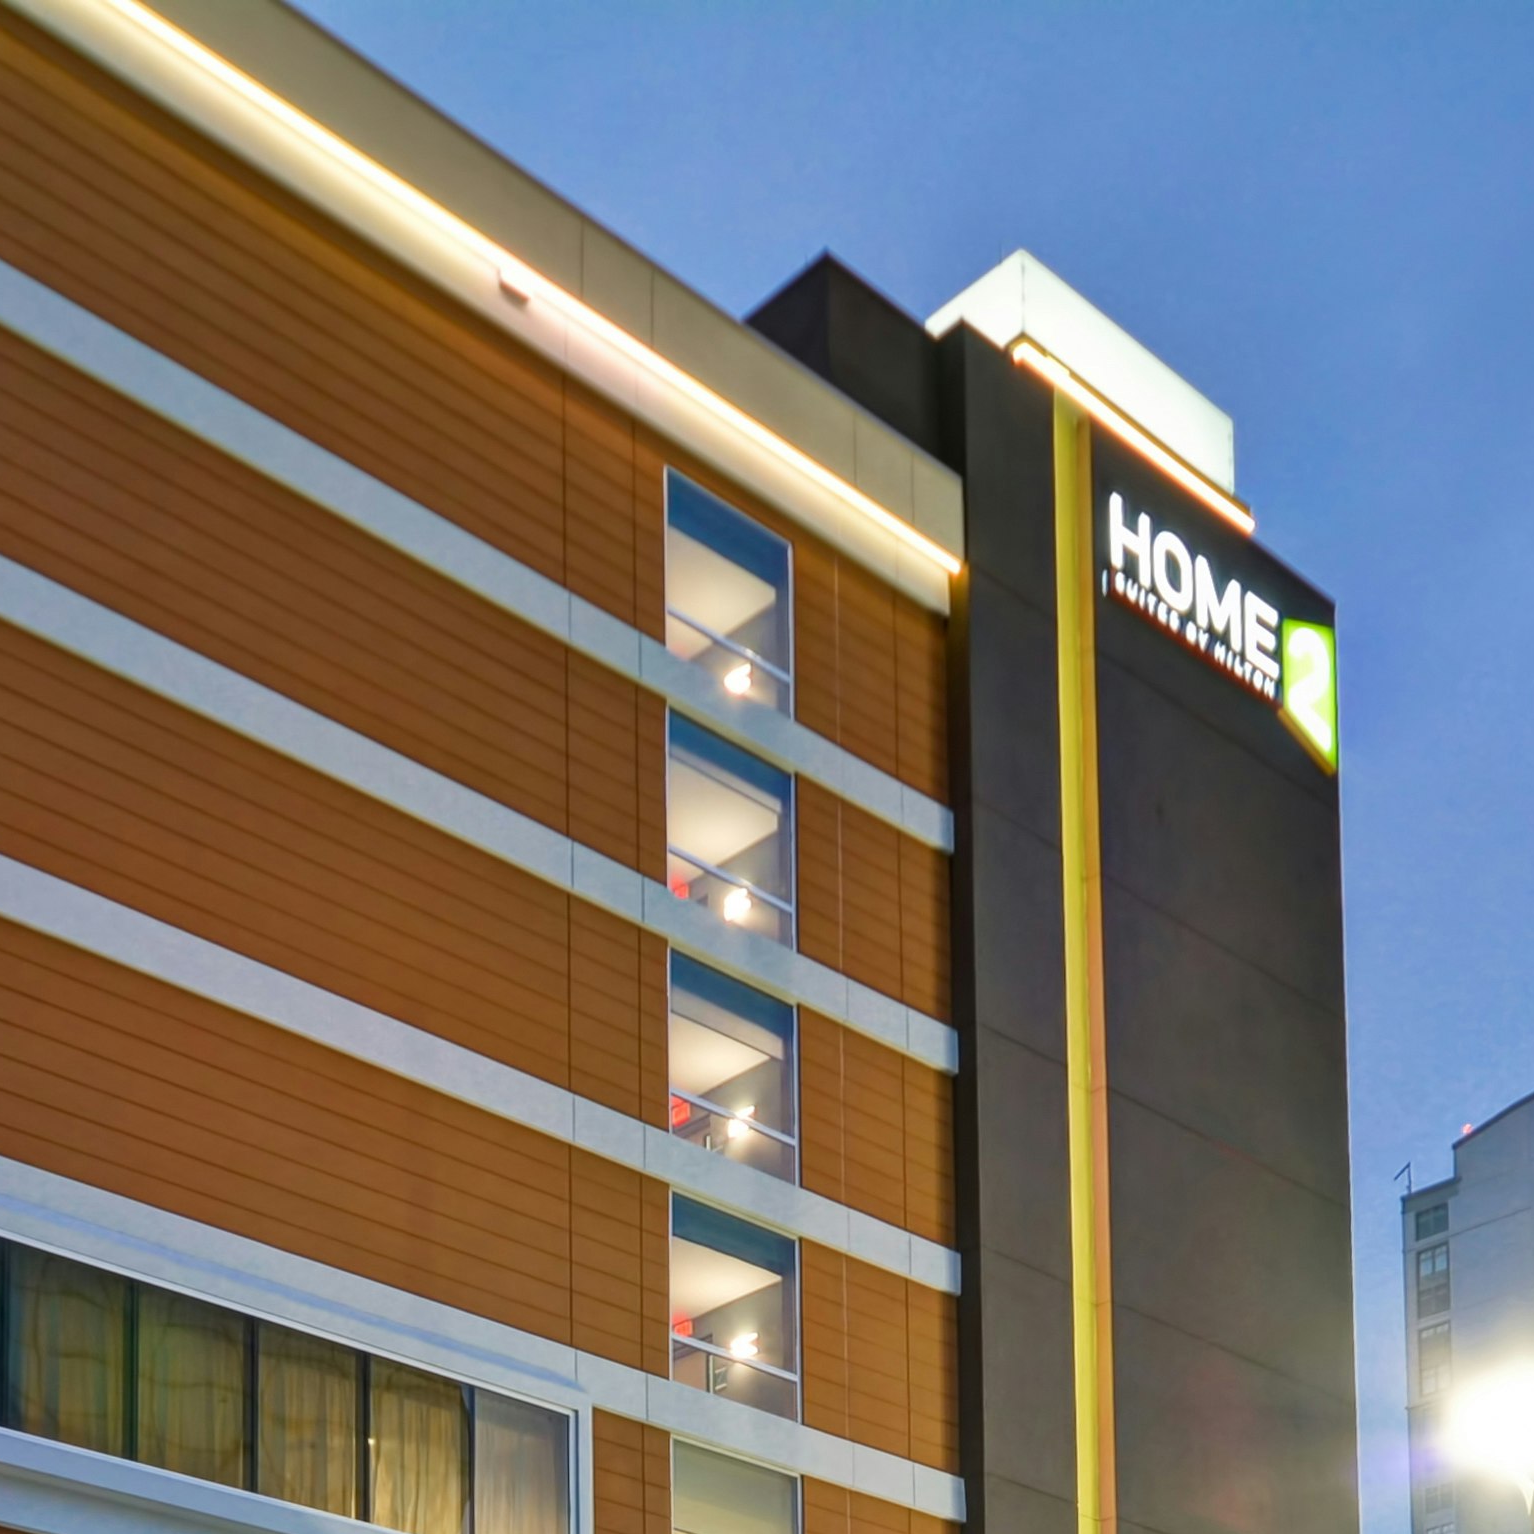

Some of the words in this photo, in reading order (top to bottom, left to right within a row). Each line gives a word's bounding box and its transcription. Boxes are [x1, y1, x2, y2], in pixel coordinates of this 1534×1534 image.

[1109, 491, 1280, 680] HOME
[1287, 626, 1332, 753] 2
[1114, 570, 1182, 635] SUITES
[1186, 620, 1210, 652] BY
[1214, 640, 1276, 700] HILTON
